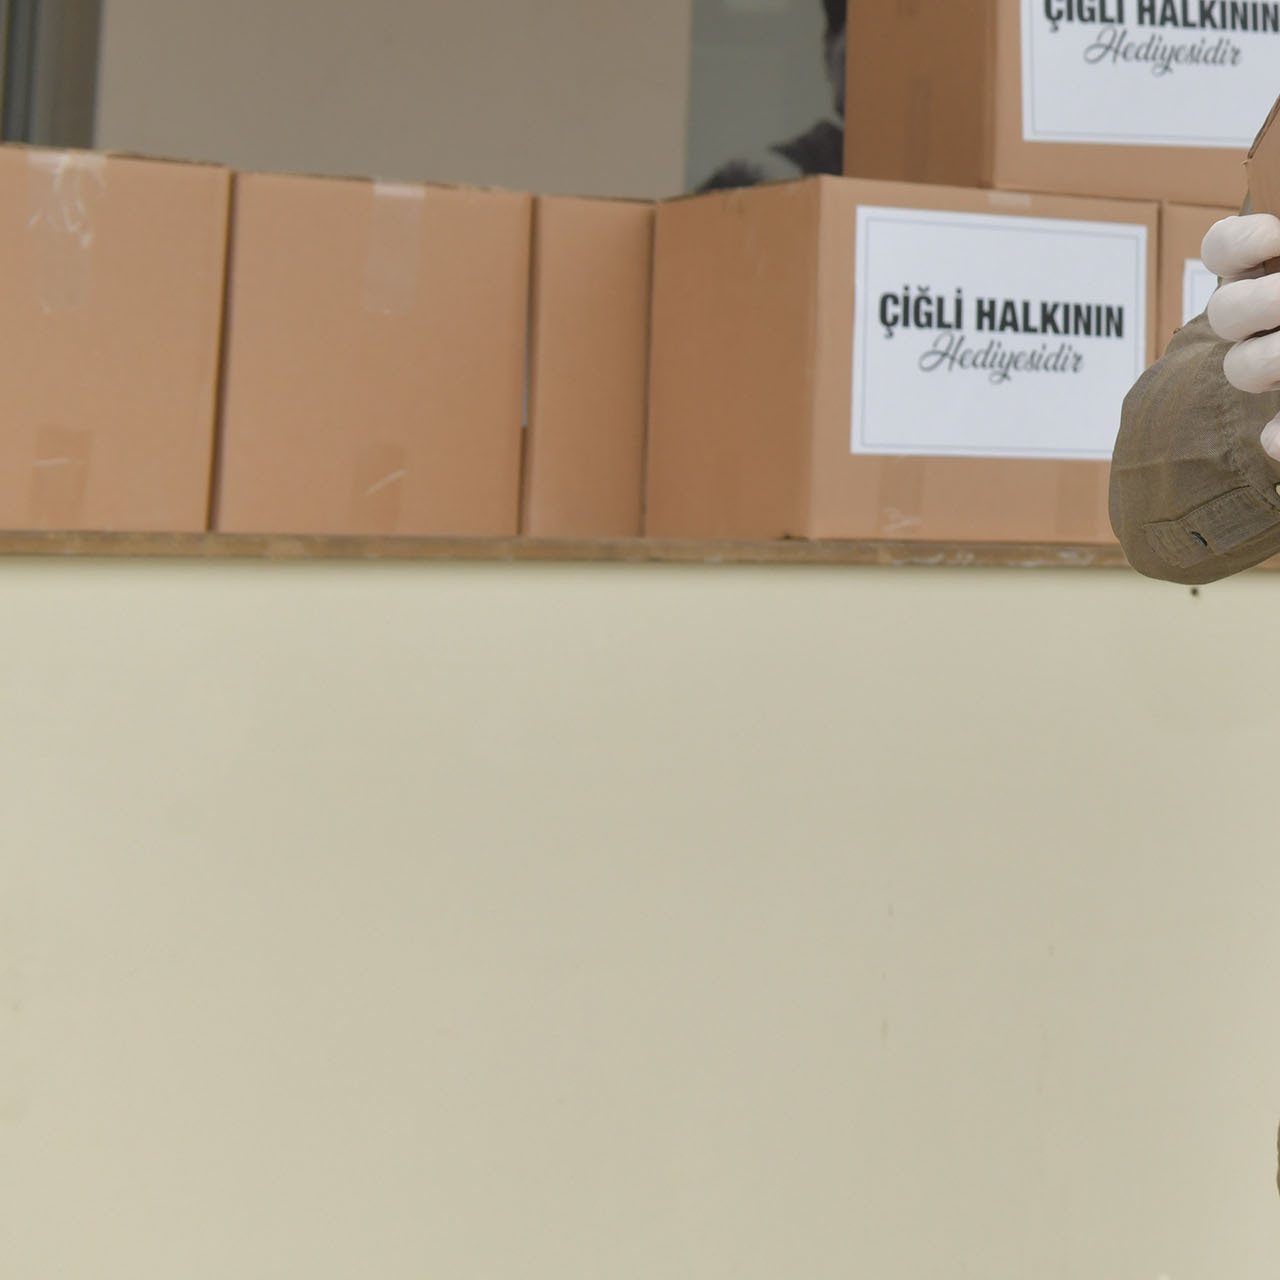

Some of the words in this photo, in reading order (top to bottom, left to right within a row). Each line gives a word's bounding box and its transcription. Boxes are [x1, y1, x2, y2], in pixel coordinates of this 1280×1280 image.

[1083, 28, 1242, 76] Hediyesidir
[878, 284, 964, 338] ÇİĞLİ
[974, 298, 1125, 339] HALKININ
[917, 331, 1084, 383] Hediyesidir
